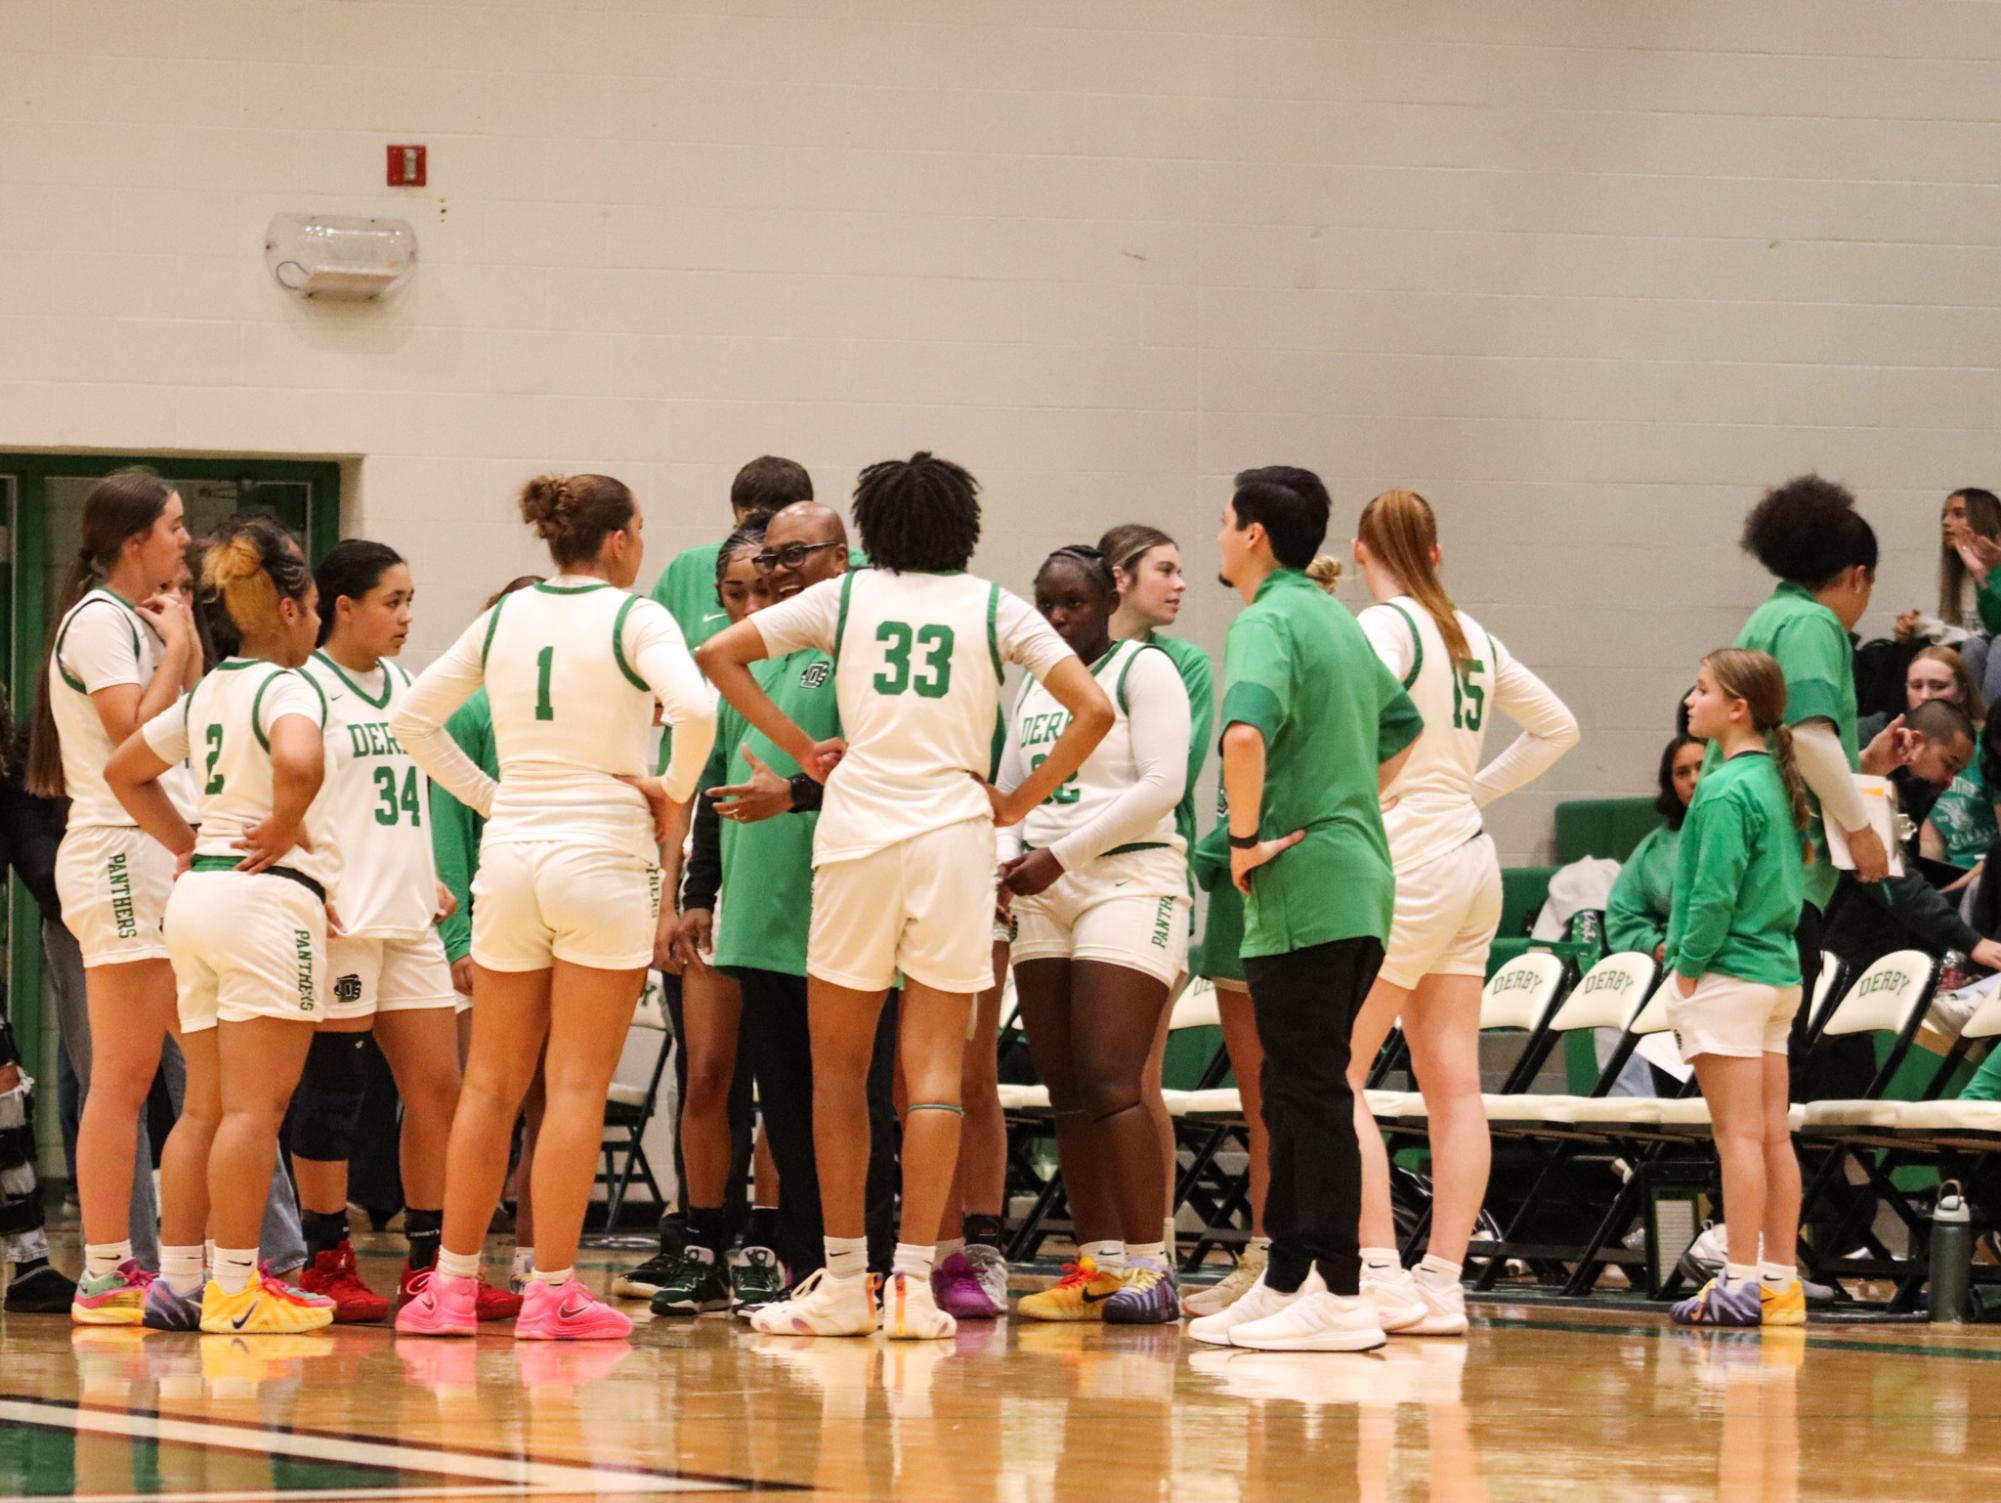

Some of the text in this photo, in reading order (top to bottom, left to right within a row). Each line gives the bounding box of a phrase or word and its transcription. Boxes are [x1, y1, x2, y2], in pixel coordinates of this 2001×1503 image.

[535, 646, 554, 721] 1
[873, 620, 955, 699] 33
[1452, 659, 1485, 731] 15
[205, 724, 225, 795] 2
[346, 722, 409, 758] DER
[373, 766, 421, 827] 34
[108, 852, 138, 939] PANTHERS
[1492, 970, 1544, 996] DERBY
[1583, 970, 1635, 996] DERBY
[1858, 971, 1911, 998] DERBY
